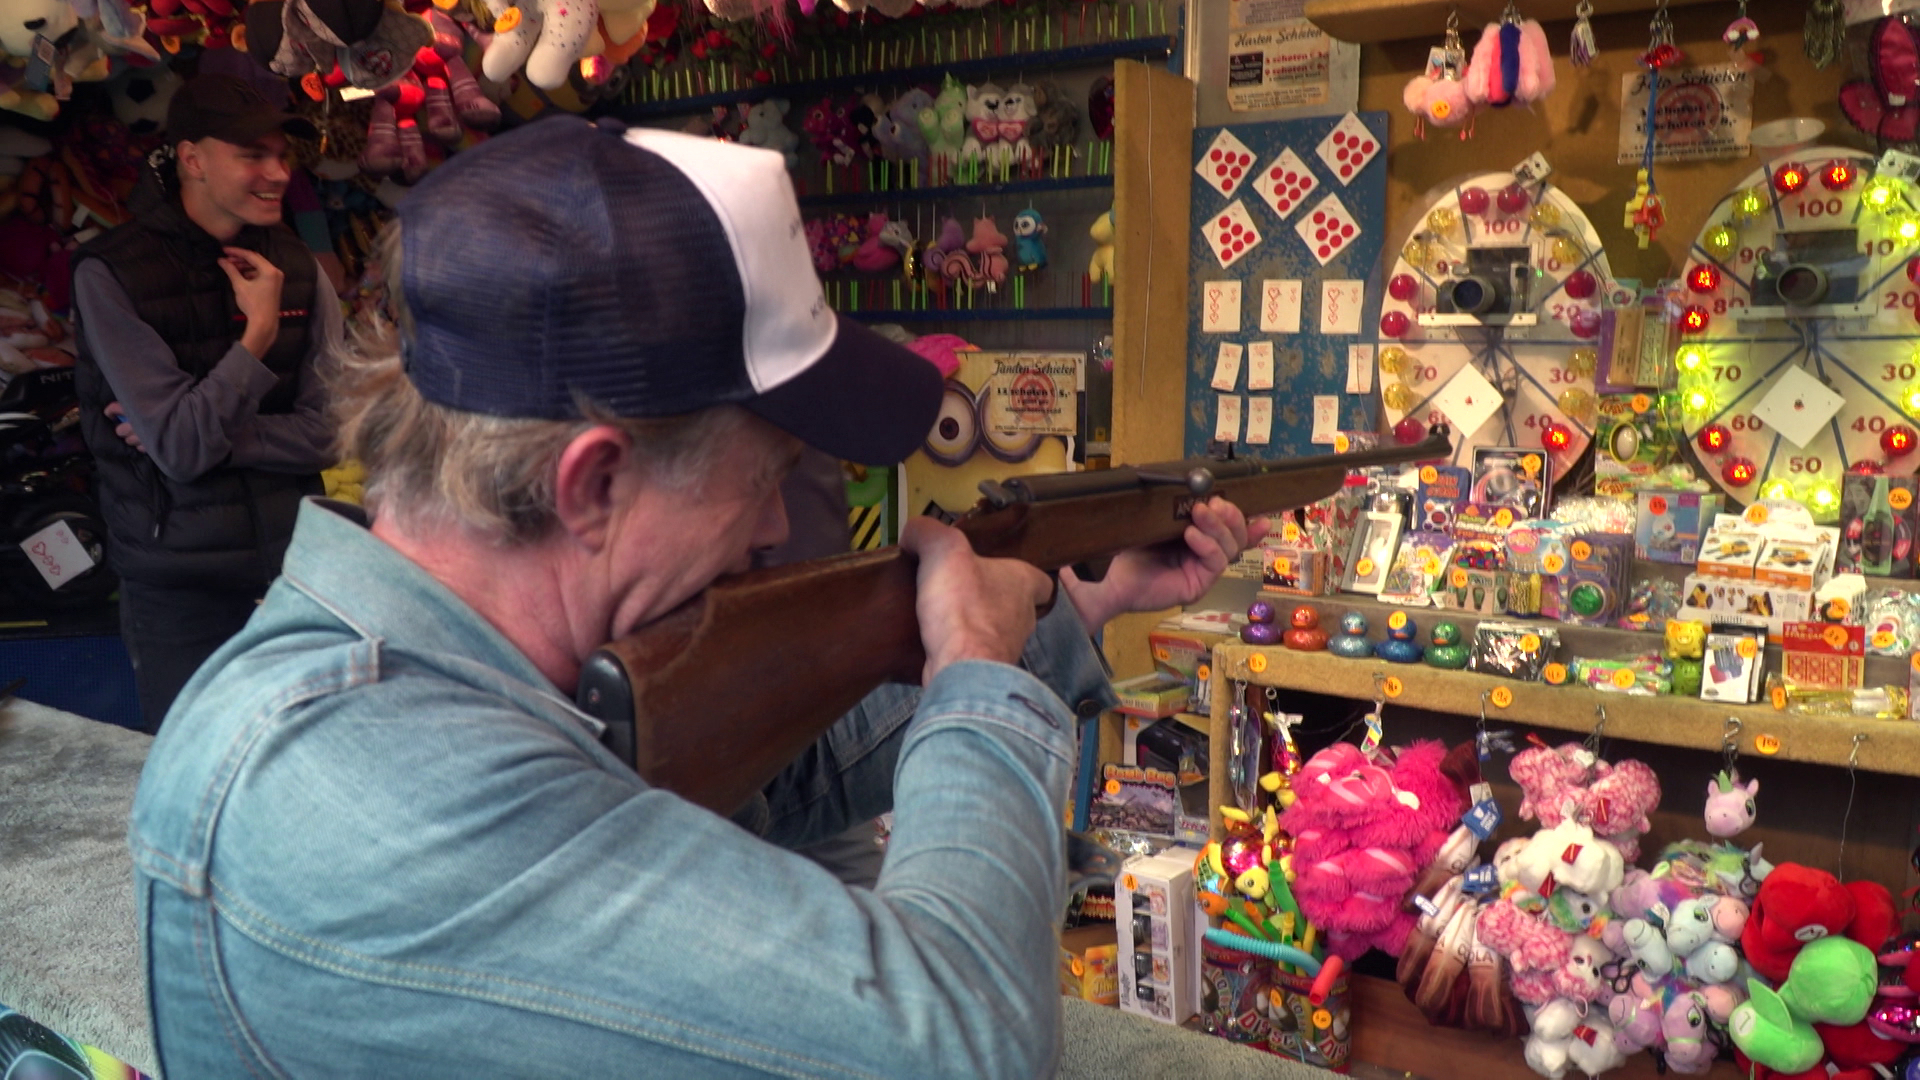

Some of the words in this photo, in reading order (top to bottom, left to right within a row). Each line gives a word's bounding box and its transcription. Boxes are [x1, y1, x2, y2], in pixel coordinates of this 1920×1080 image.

[1798, 198, 1843, 218] 100
[1484, 219, 1521, 235] 100
[1864, 239, 1895, 258] 10
[1884, 291, 1919, 310] 20
[1412, 365, 1438, 381] 70
[1549, 366, 1577, 384] 30
[1712, 364, 1742, 383] 70
[1881, 363, 1917, 381] 30
[1524, 413, 1554, 431] 40
[1732, 413, 1763, 432] 60
[1851, 415, 1886, 434] 40
[1789, 455, 1823, 474] 50
